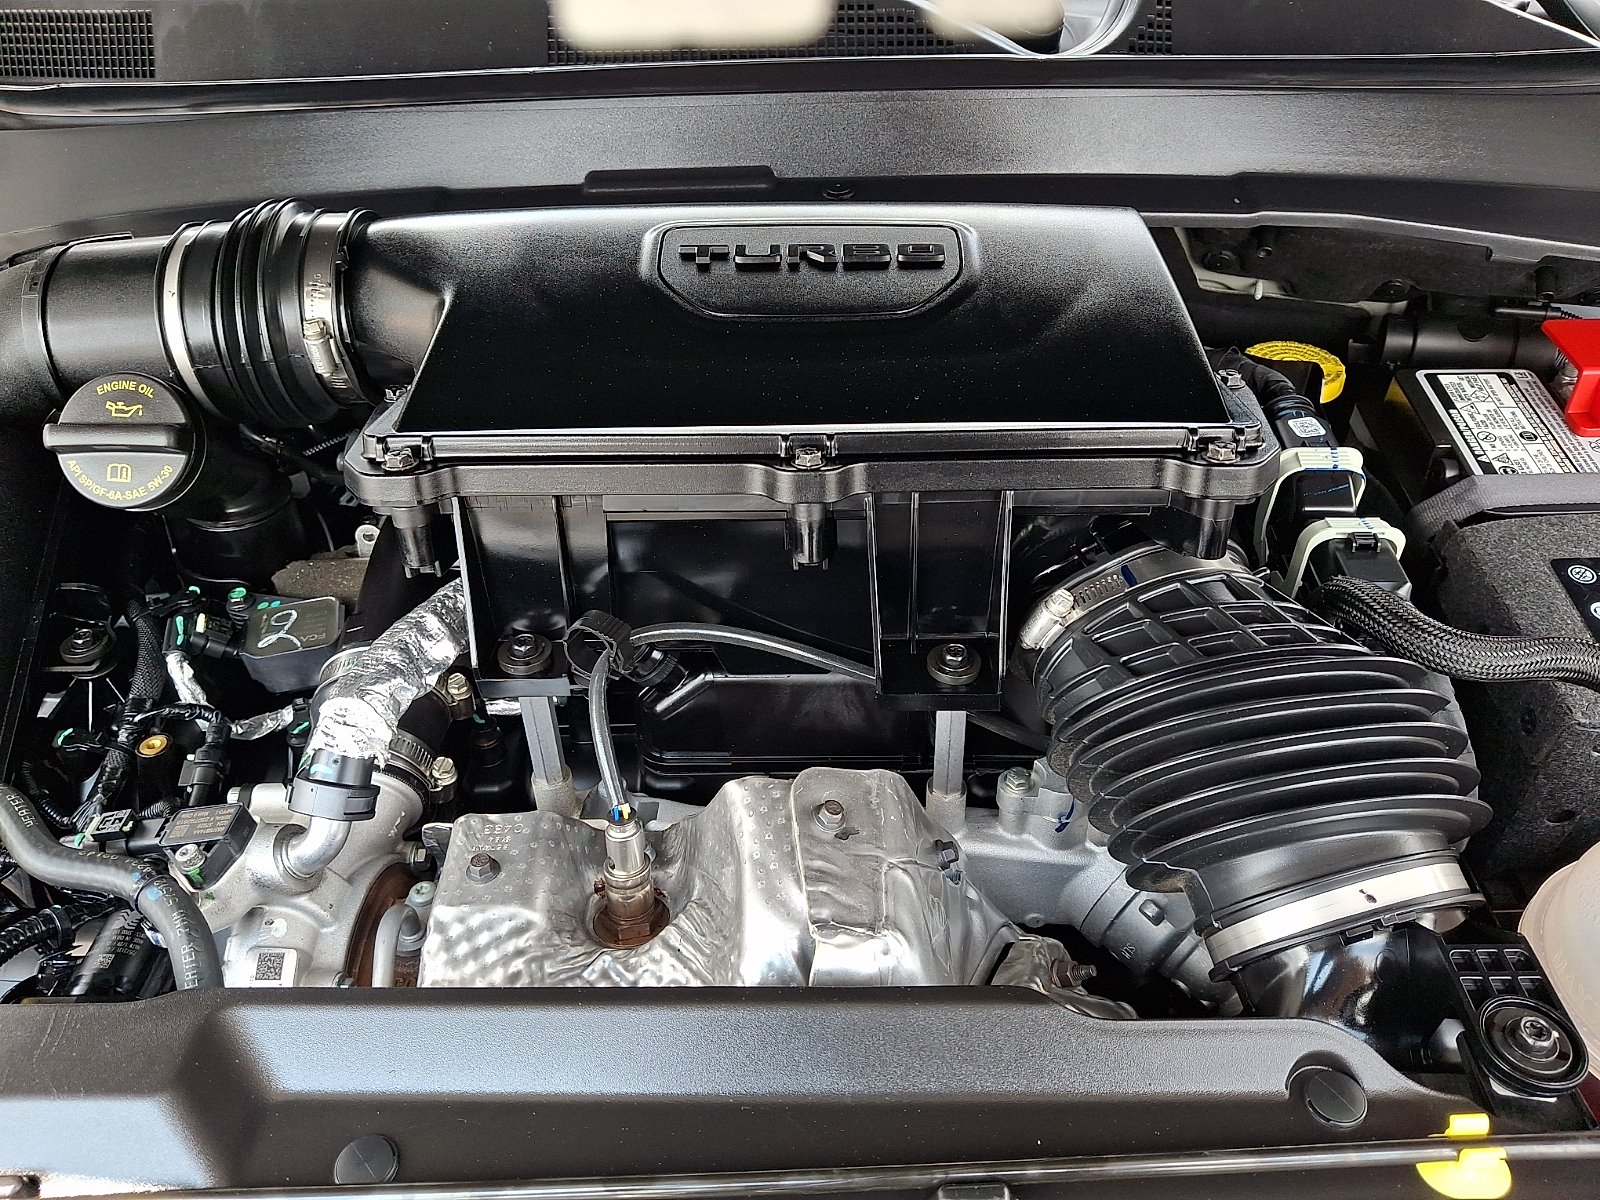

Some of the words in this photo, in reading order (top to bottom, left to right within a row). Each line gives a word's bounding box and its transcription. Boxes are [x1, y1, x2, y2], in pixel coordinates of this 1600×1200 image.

[678, 243, 946, 271] TURBO
[96, 380, 137, 396] ENGINE
[138, 384, 154, 399] OIL
[67, 459, 83, 476] API
[148, 464, 173, 492] 5W-30
